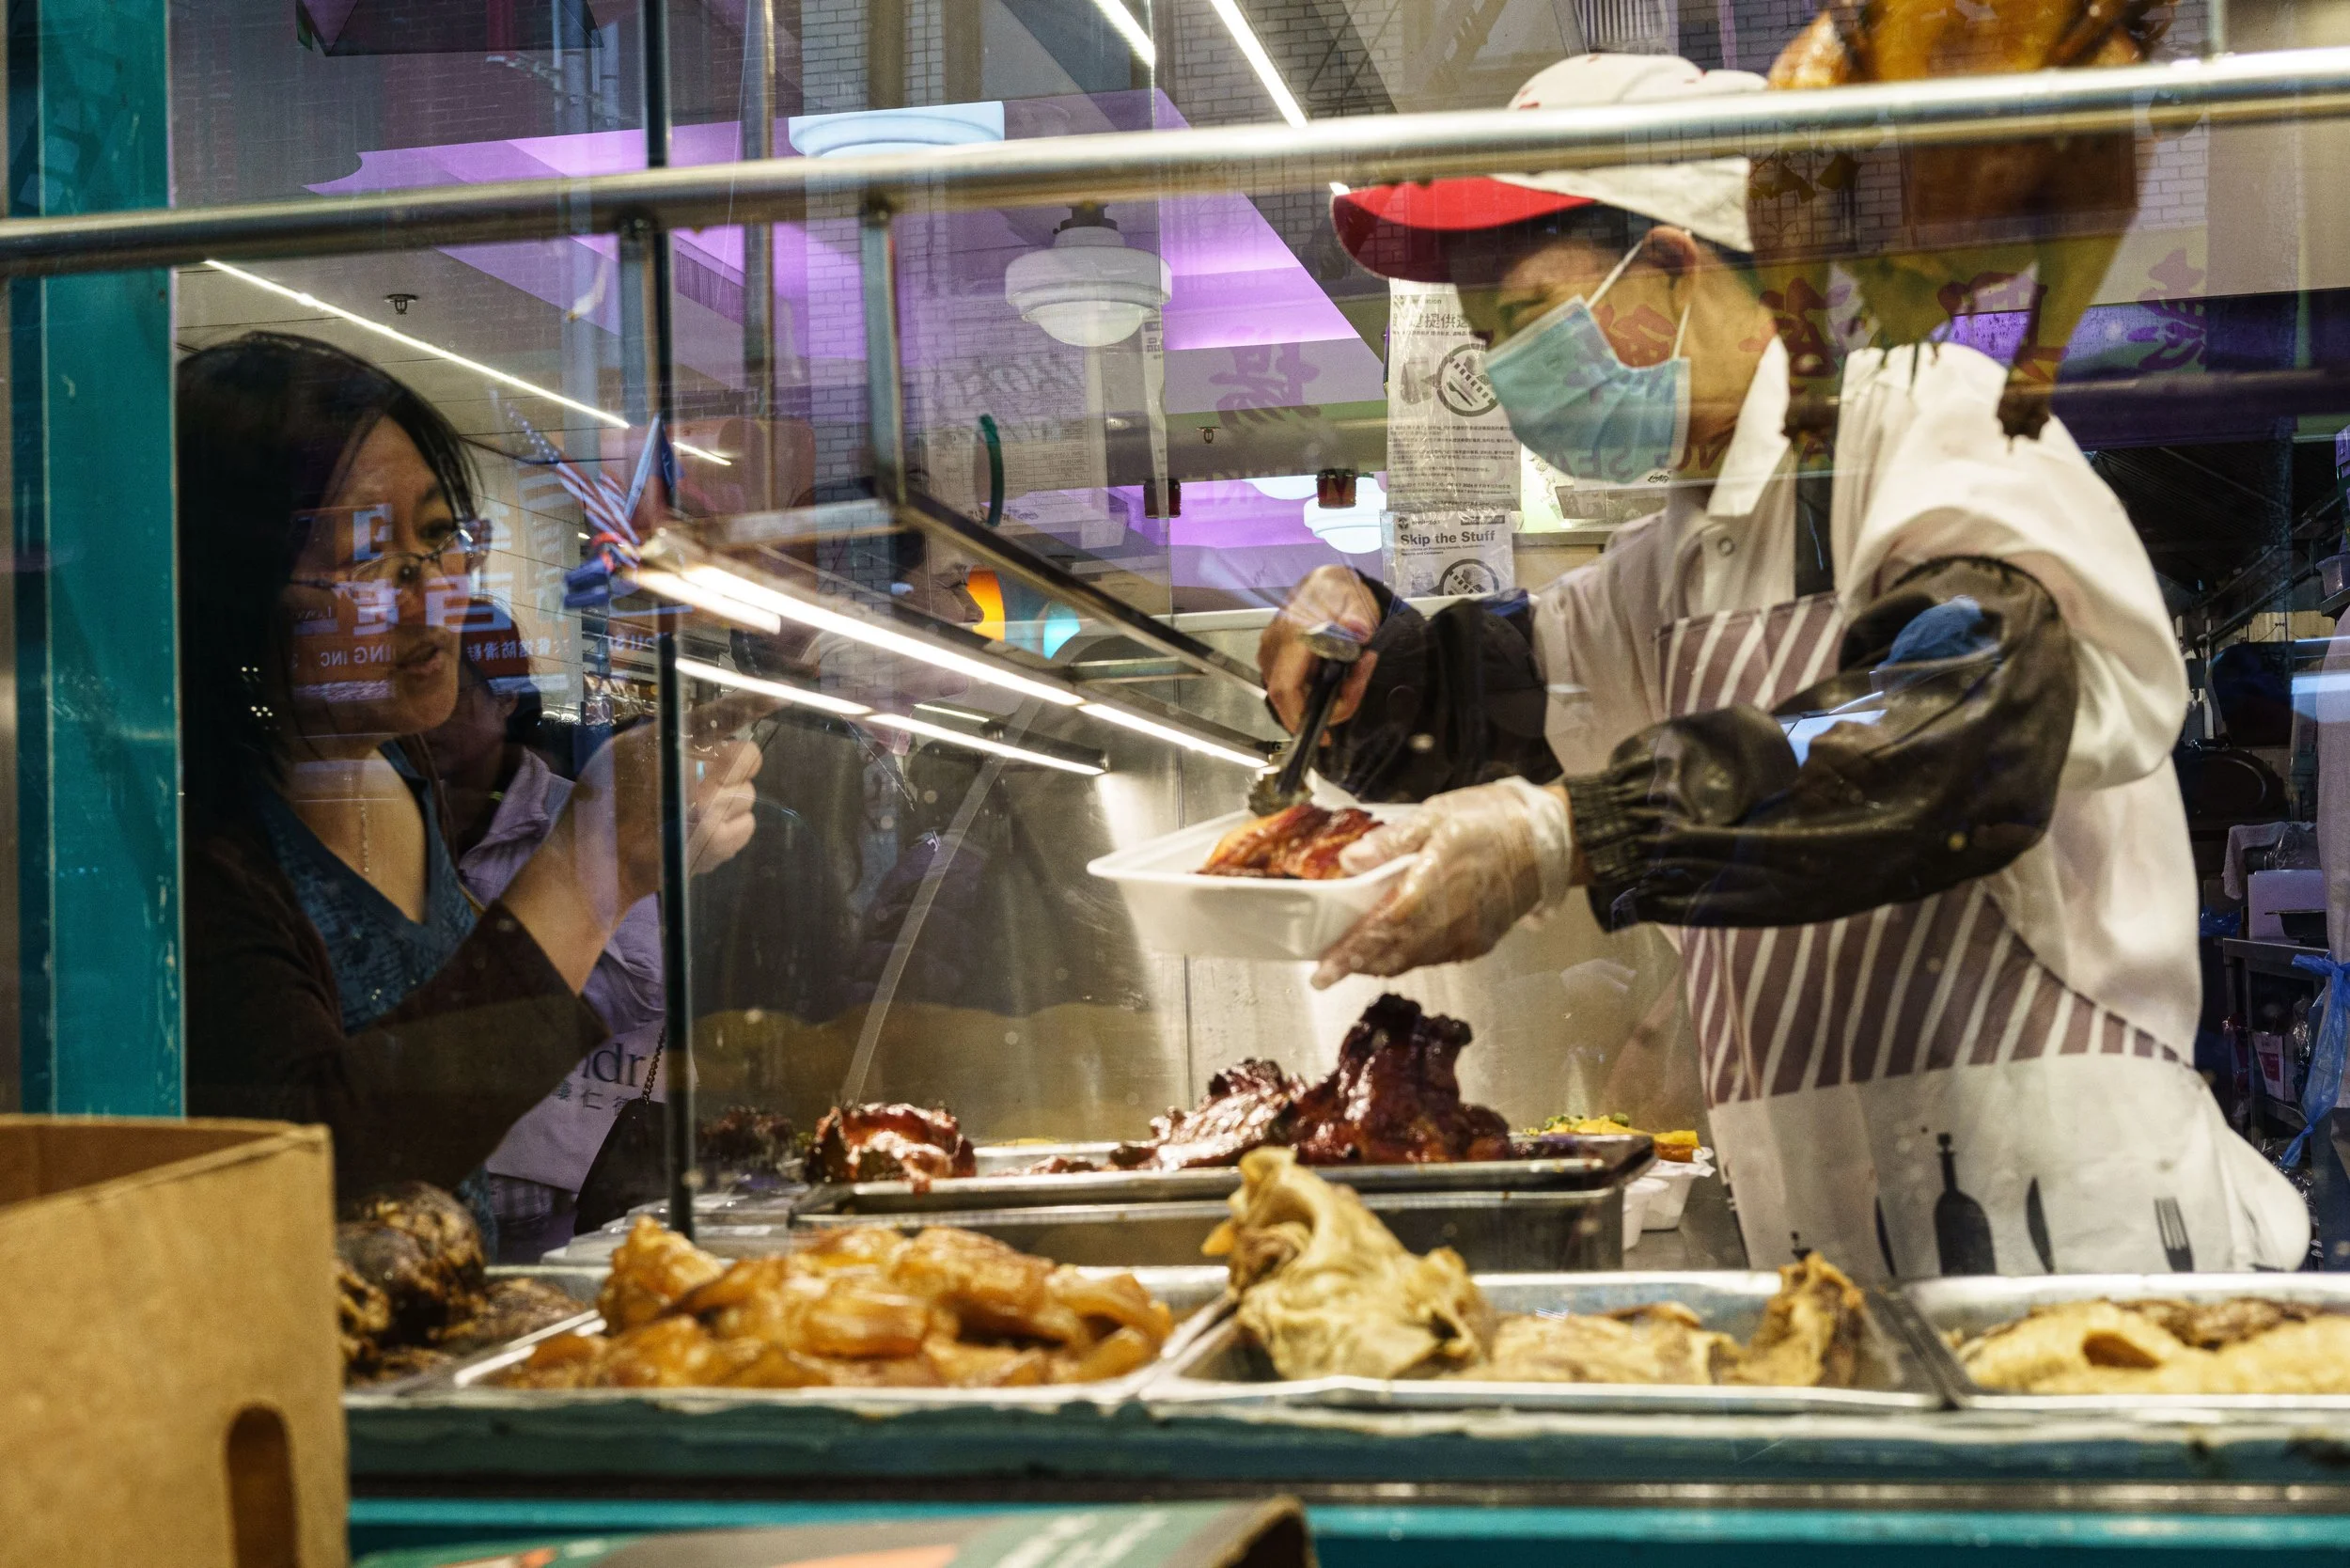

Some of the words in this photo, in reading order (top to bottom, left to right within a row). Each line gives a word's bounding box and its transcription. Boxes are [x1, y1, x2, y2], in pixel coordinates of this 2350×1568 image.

[1400, 533, 1431, 547] Skip
[1434, 532, 1457, 544] the
[1461, 530, 1496, 543] Stuff
